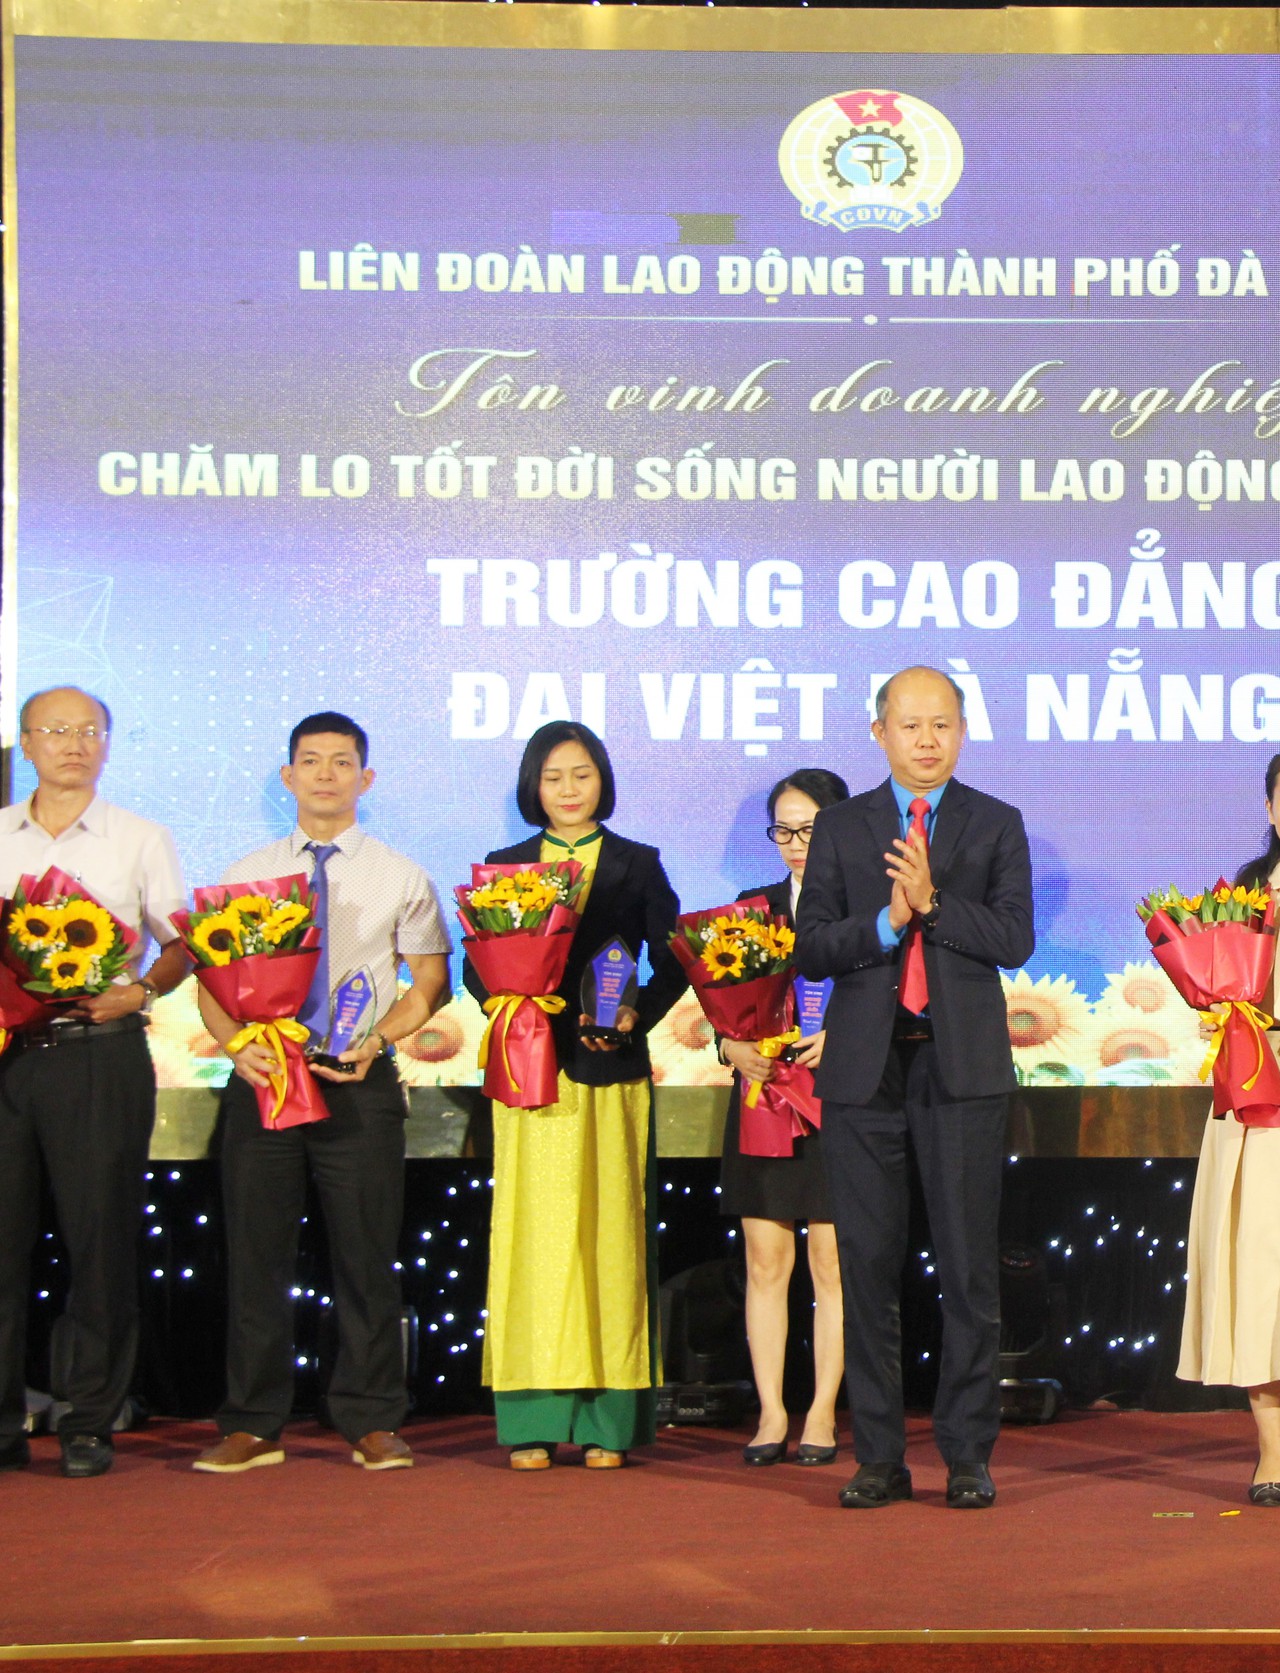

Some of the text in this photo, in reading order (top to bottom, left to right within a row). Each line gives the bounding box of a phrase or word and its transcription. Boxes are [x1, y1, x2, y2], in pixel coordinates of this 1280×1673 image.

[298, 244, 419, 290] LIÊN
[437, 246, 585, 293] ĐOÀN
[604, 255, 699, 294] LAO
[717, 248, 864, 302] ĐỘNG
[883, 248, 1055, 296] THÀNH
[1073, 244, 1181, 296] PHỐ
[1196, 250, 1268, 297] ĐÀ
[394, 347, 566, 417] Tôn
[605, 358, 788, 413] vinh
[810, 358, 1064, 414] doanh
[98, 443, 279, 496] CHĂM
[300, 454, 370, 497] LO
[390, 440, 497, 498] TỐT
[515, 447, 613, 499] ĐỜI
[635, 440, 797, 500] SỐNG
[817, 448, 998, 500] NGƯỜI
[1021, 459, 1124, 500] LAO
[427, 544, 804, 628] TRƯỜNG
[837, 560, 1019, 629] CAO
[639, 656, 837, 756] VIỆT
